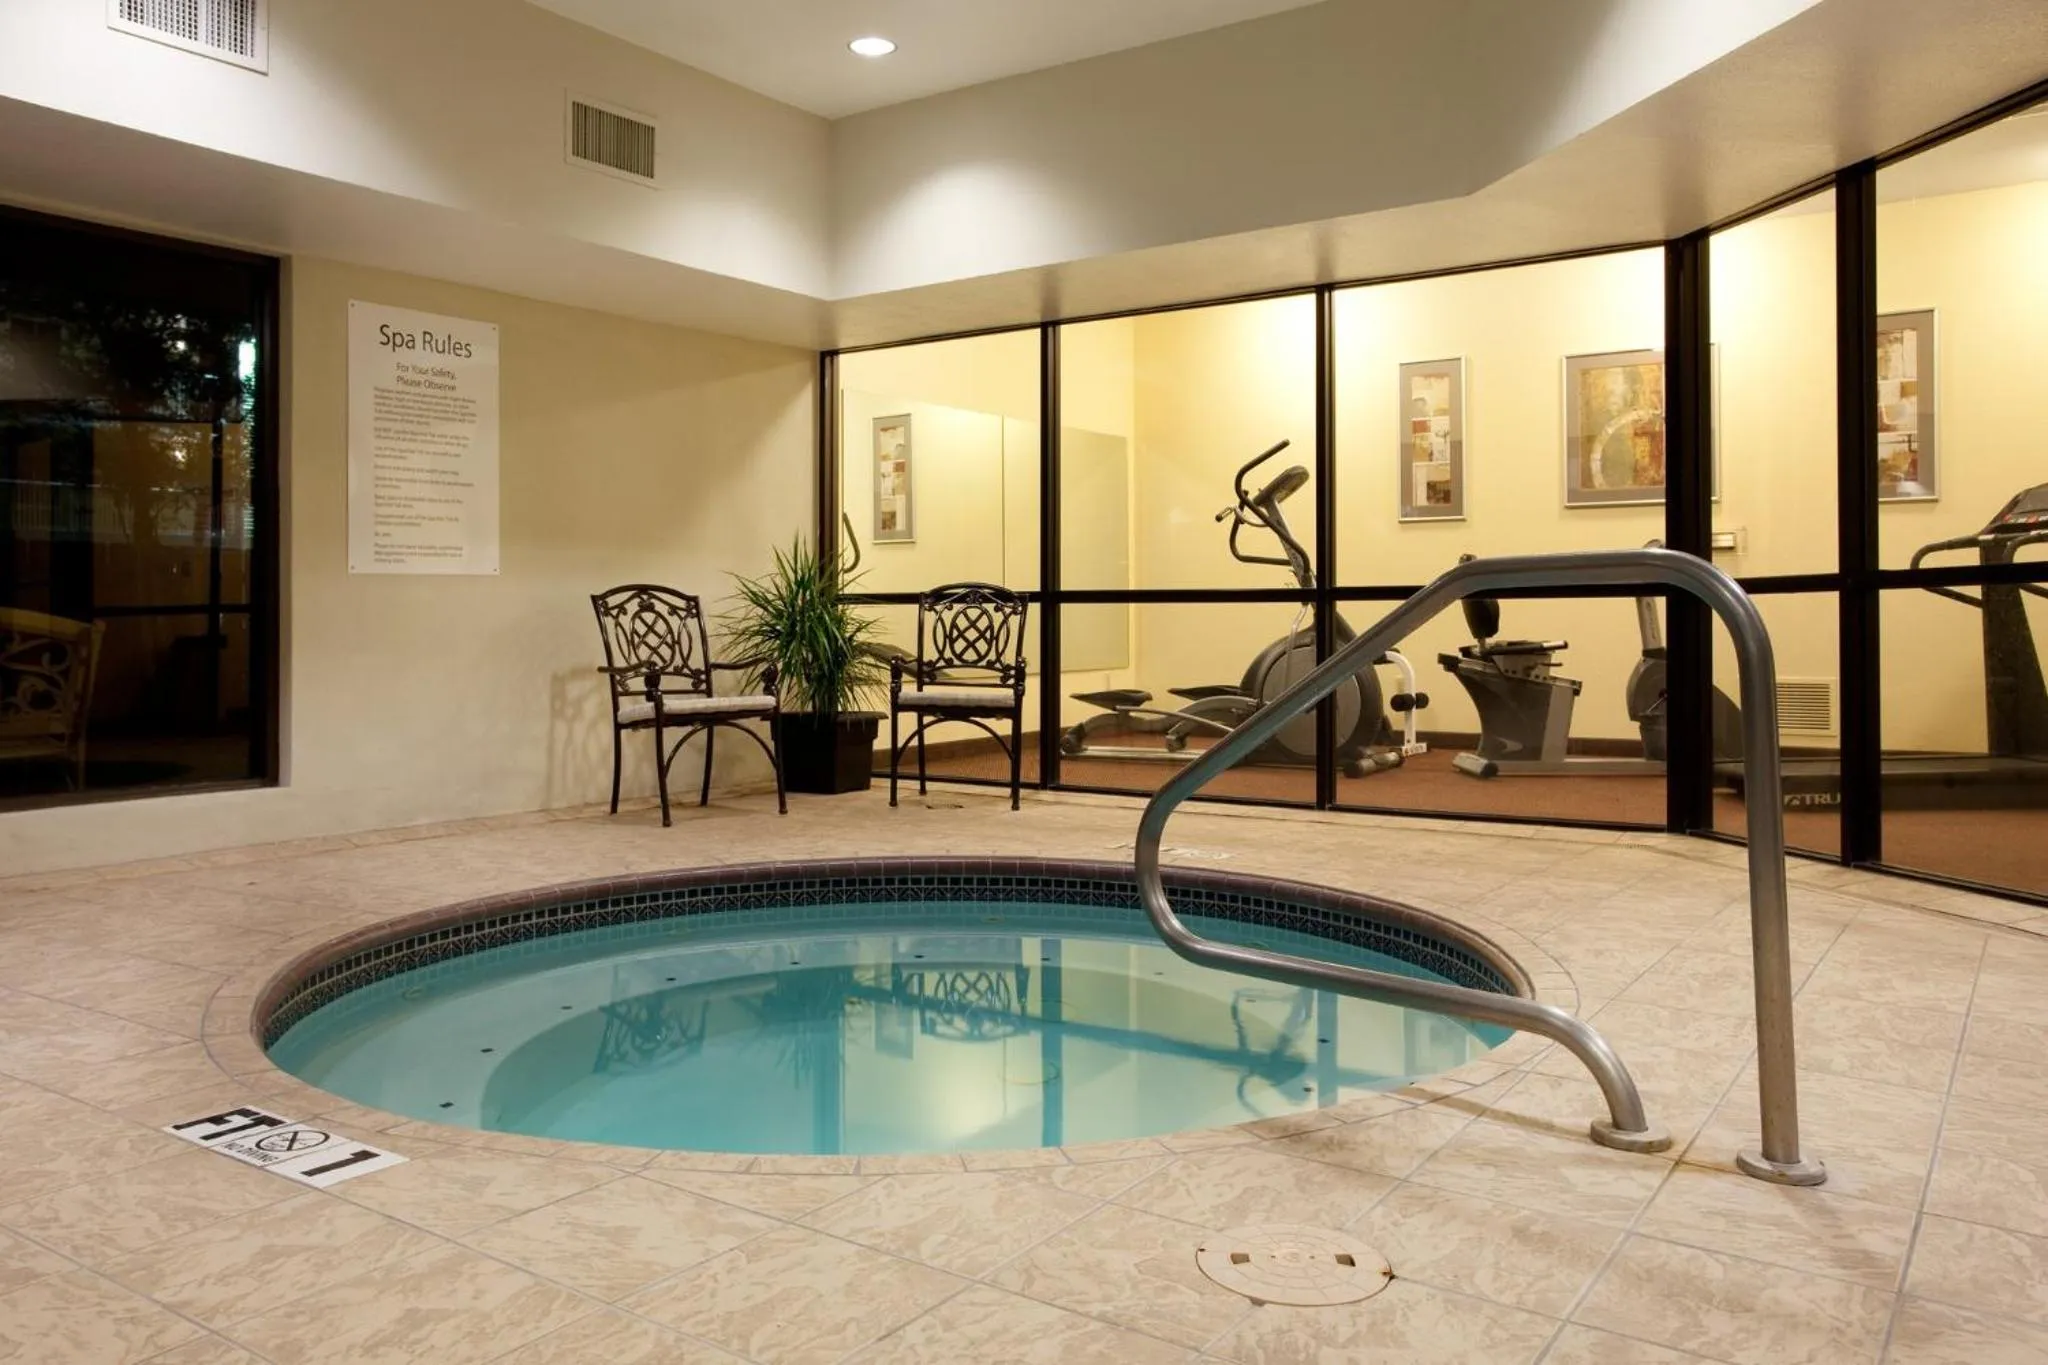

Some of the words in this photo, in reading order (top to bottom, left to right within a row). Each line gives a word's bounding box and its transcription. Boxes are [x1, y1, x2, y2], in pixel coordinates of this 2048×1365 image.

[380, 324, 415, 352] Spa
[422, 331, 472, 358] Rules
[396, 362, 409, 373] For
[411, 364, 428, 375] Your
[396, 375, 421, 387] Please
[424, 379, 456, 391] Observe
[1804, 792, 1841, 806] TRU
[172, 1107, 287, 1140] FT
[236, 1147, 281, 1162] DIVING
[301, 1149, 381, 1177] 1
